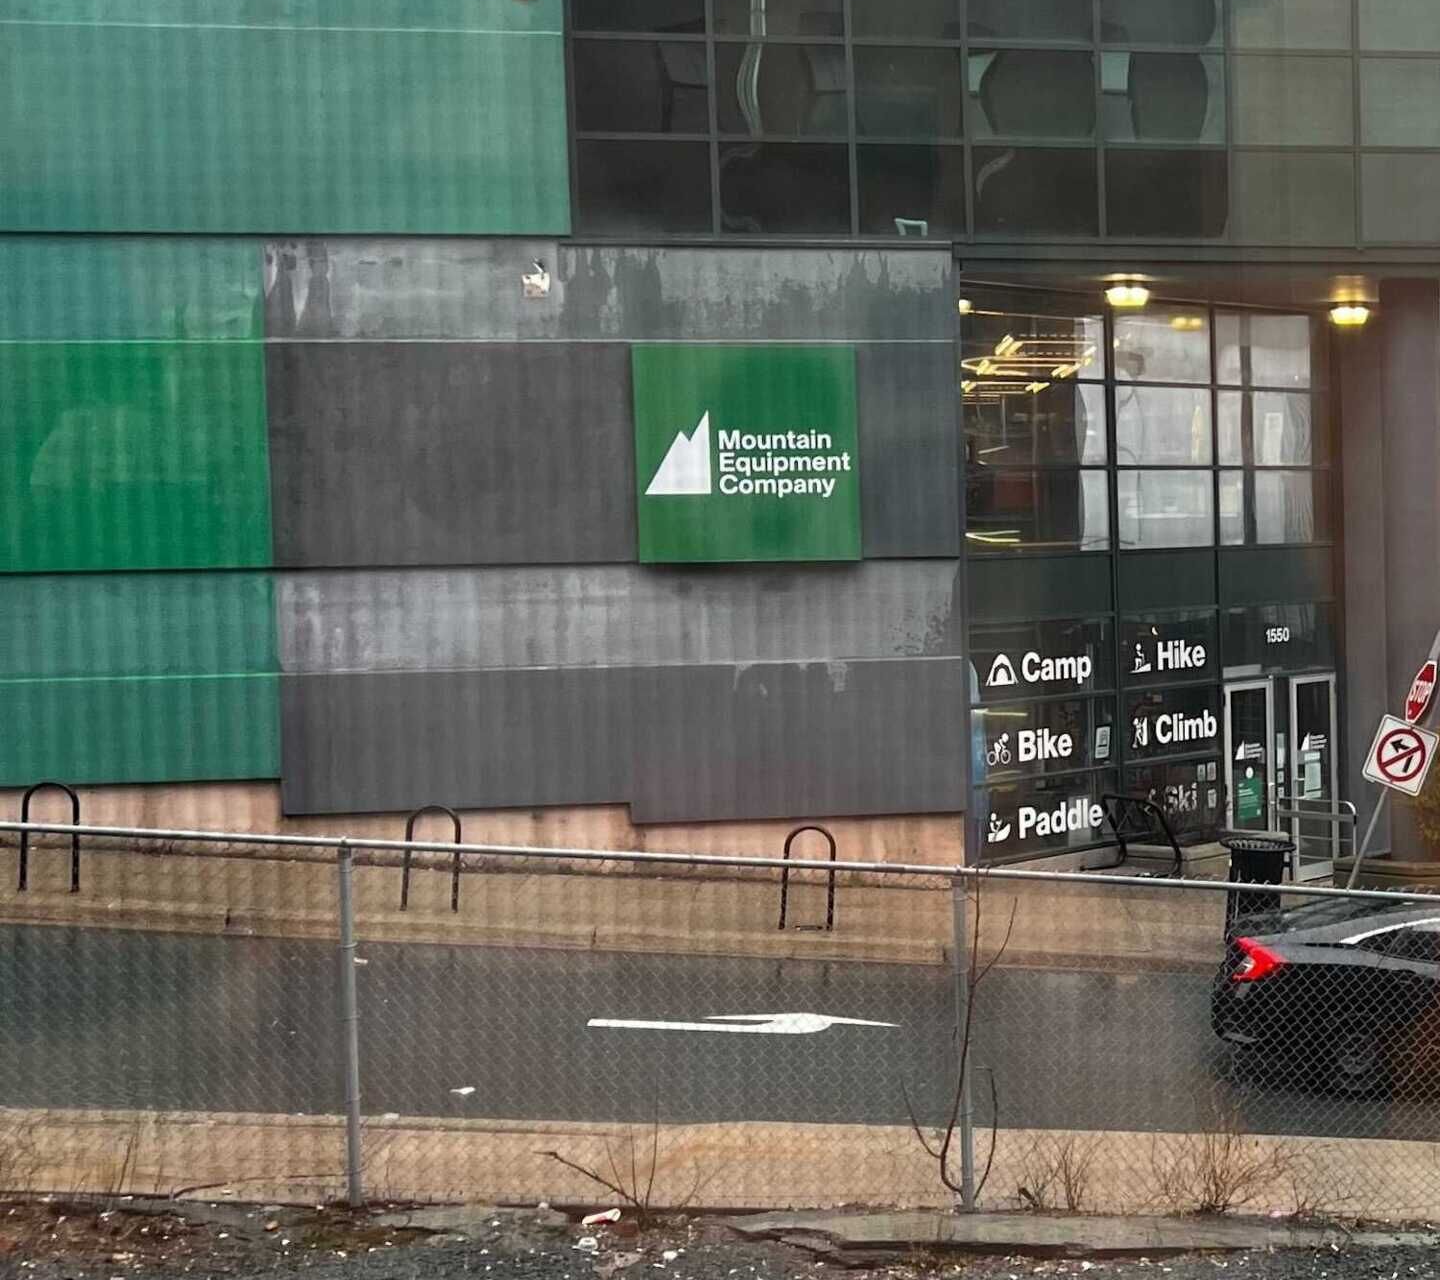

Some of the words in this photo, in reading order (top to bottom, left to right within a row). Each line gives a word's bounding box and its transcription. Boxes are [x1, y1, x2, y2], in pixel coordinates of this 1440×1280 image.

[718, 429, 832, 450] Mountain
[719, 452, 852, 476] Equipment
[719, 474, 836, 498] Company
[1266, 627, 1290, 643] 1550
[1022, 651, 1092, 684] Camp
[1157, 639, 1206, 670] Hike
[1410, 680, 1433, 704] STOP
[1156, 709, 1218, 744] Climb
[1018, 728, 1073, 762] Bike
[1162, 782, 1198, 813] Ski
[1018, 798, 1104, 839] Paddle
